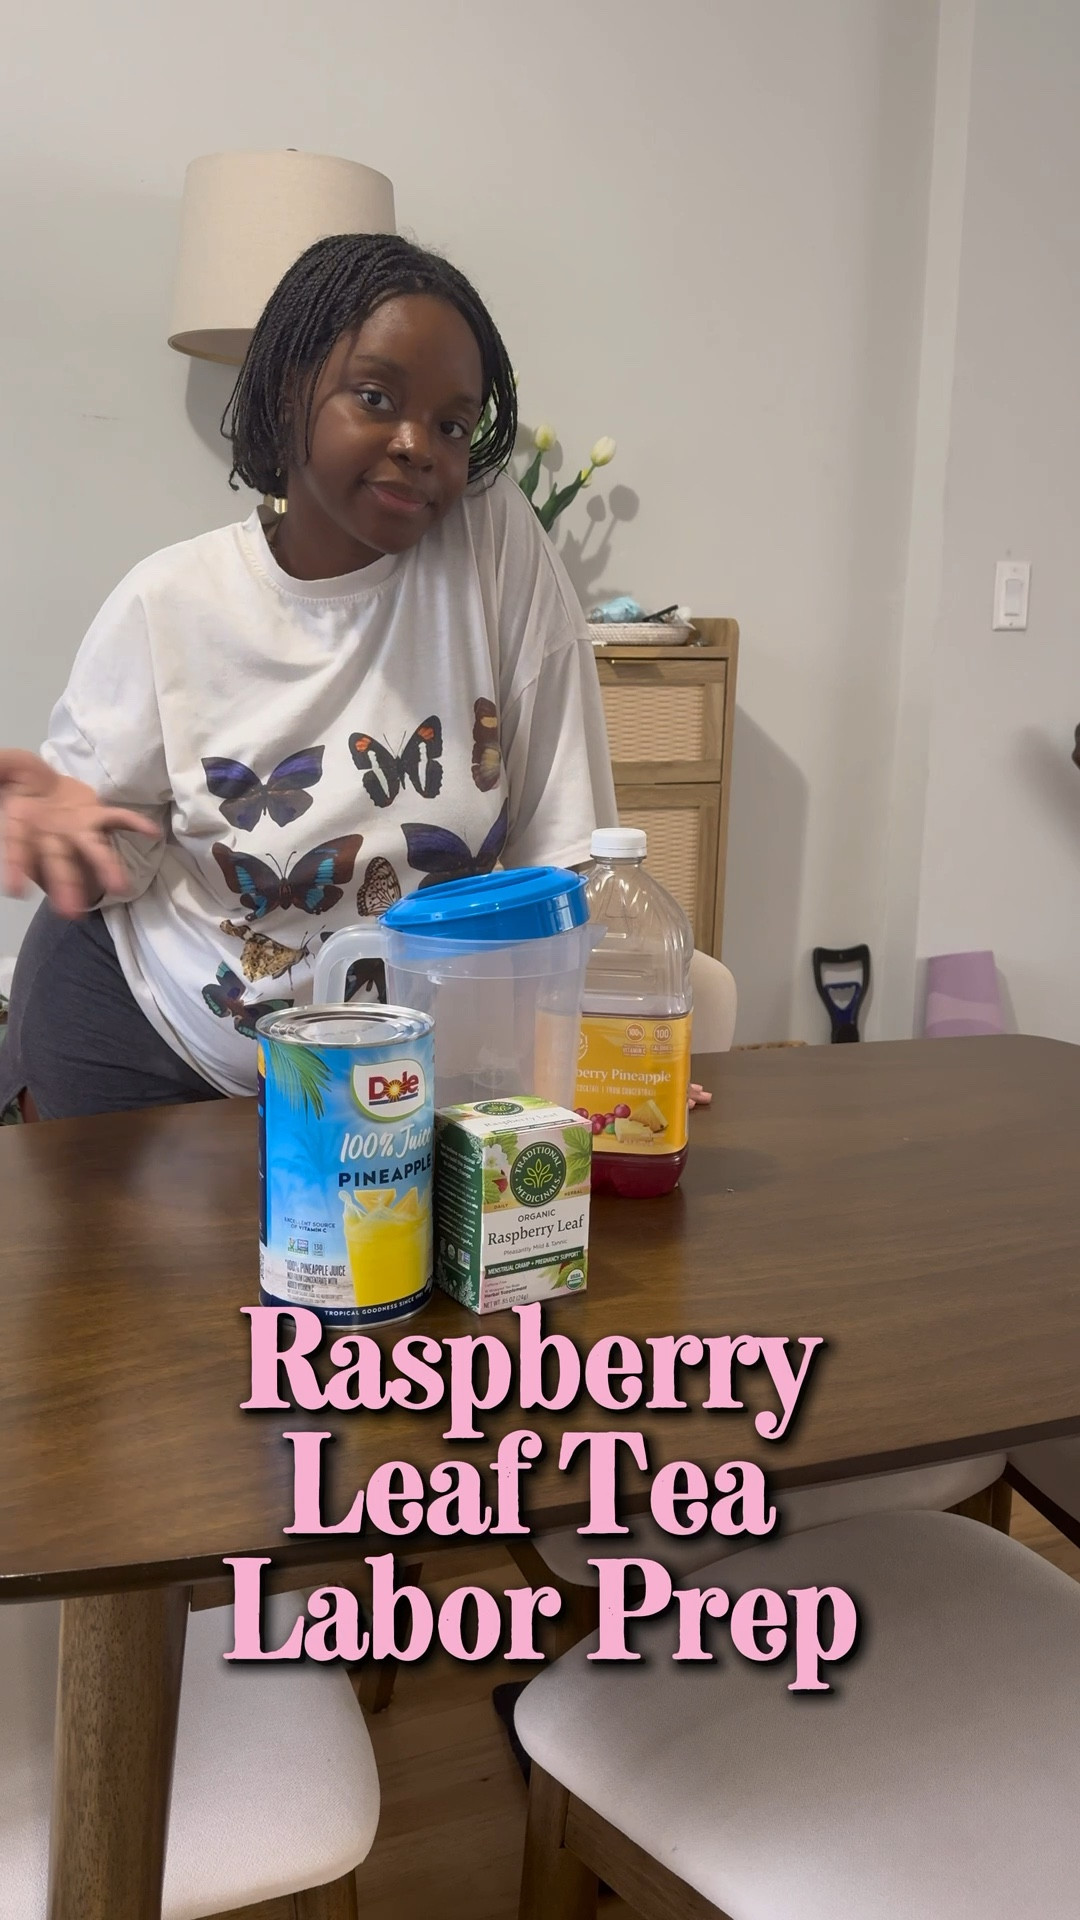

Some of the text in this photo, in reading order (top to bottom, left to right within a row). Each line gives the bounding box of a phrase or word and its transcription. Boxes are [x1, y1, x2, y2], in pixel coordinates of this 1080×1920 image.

[656, 1029, 669, 1039] 100
[576, 1068, 672, 1085] berry Pineapple
[368, 1071, 419, 1101] Dole
[340, 1131, 394, 1163] 100%
[515, 1146, 562, 1174] TRADITIONAL
[338, 1153, 432, 1187] PINEAPPLE
[515, 1178, 561, 1203] MEDICINALS
[517, 1209, 556, 1222] ORGANIC
[299, 1225, 322, 1233] VITAMIN
[312, 1221, 336, 1229] SOURCE
[487, 1213, 585, 1246] Raspberry Leaf
[503, 1246, 532, 1256] Pleasantly
[532, 1243, 545, 1251] Mild
[551, 1239, 568, 1247] Tannic
[300, 1262, 328, 1276] PINEAPPLE
[330, 1264, 346, 1276] JUICE
[488, 1264, 514, 1275] MENSTRUAL
[514, 1261, 530, 1270] CRAMP
[535, 1254, 560, 1266] PREGNANCY
[484, 1285, 528, 1298] Herbal Supplement
[362, 1304, 398, 1315] GOODNESS
[399, 1296, 414, 1307] SINCE
[484, 1301, 493, 1309] NET
[508, 1295, 515, 1303] OZ
[515, 1293, 529, 1301] (24g)
